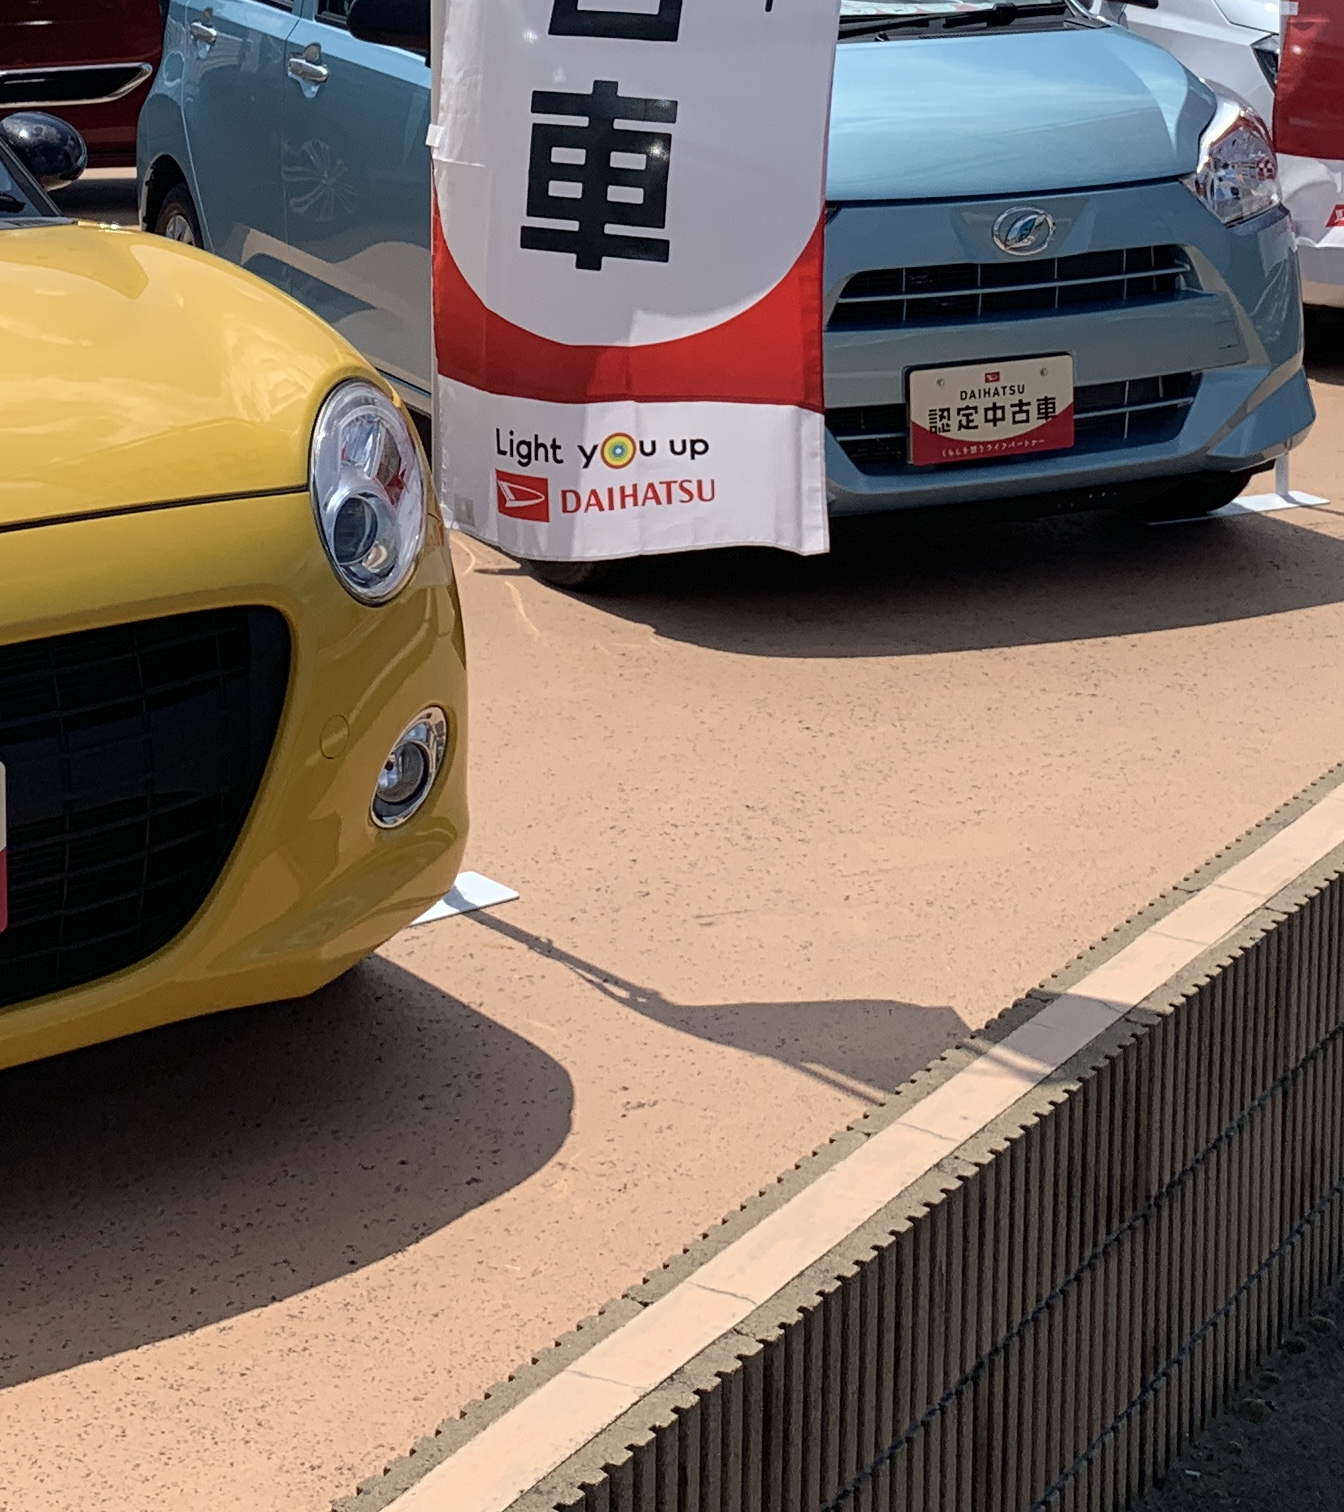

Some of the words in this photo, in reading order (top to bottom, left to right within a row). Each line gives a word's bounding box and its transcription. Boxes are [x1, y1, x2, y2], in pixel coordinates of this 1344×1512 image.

[960, 384, 1025, 401] DAIHATSU
[928, 396, 1057, 434] 認定中古車
[496, 427, 564, 467] Light
[669, 438, 709, 461] up
[561, 479, 716, 514] DAIHATSU
